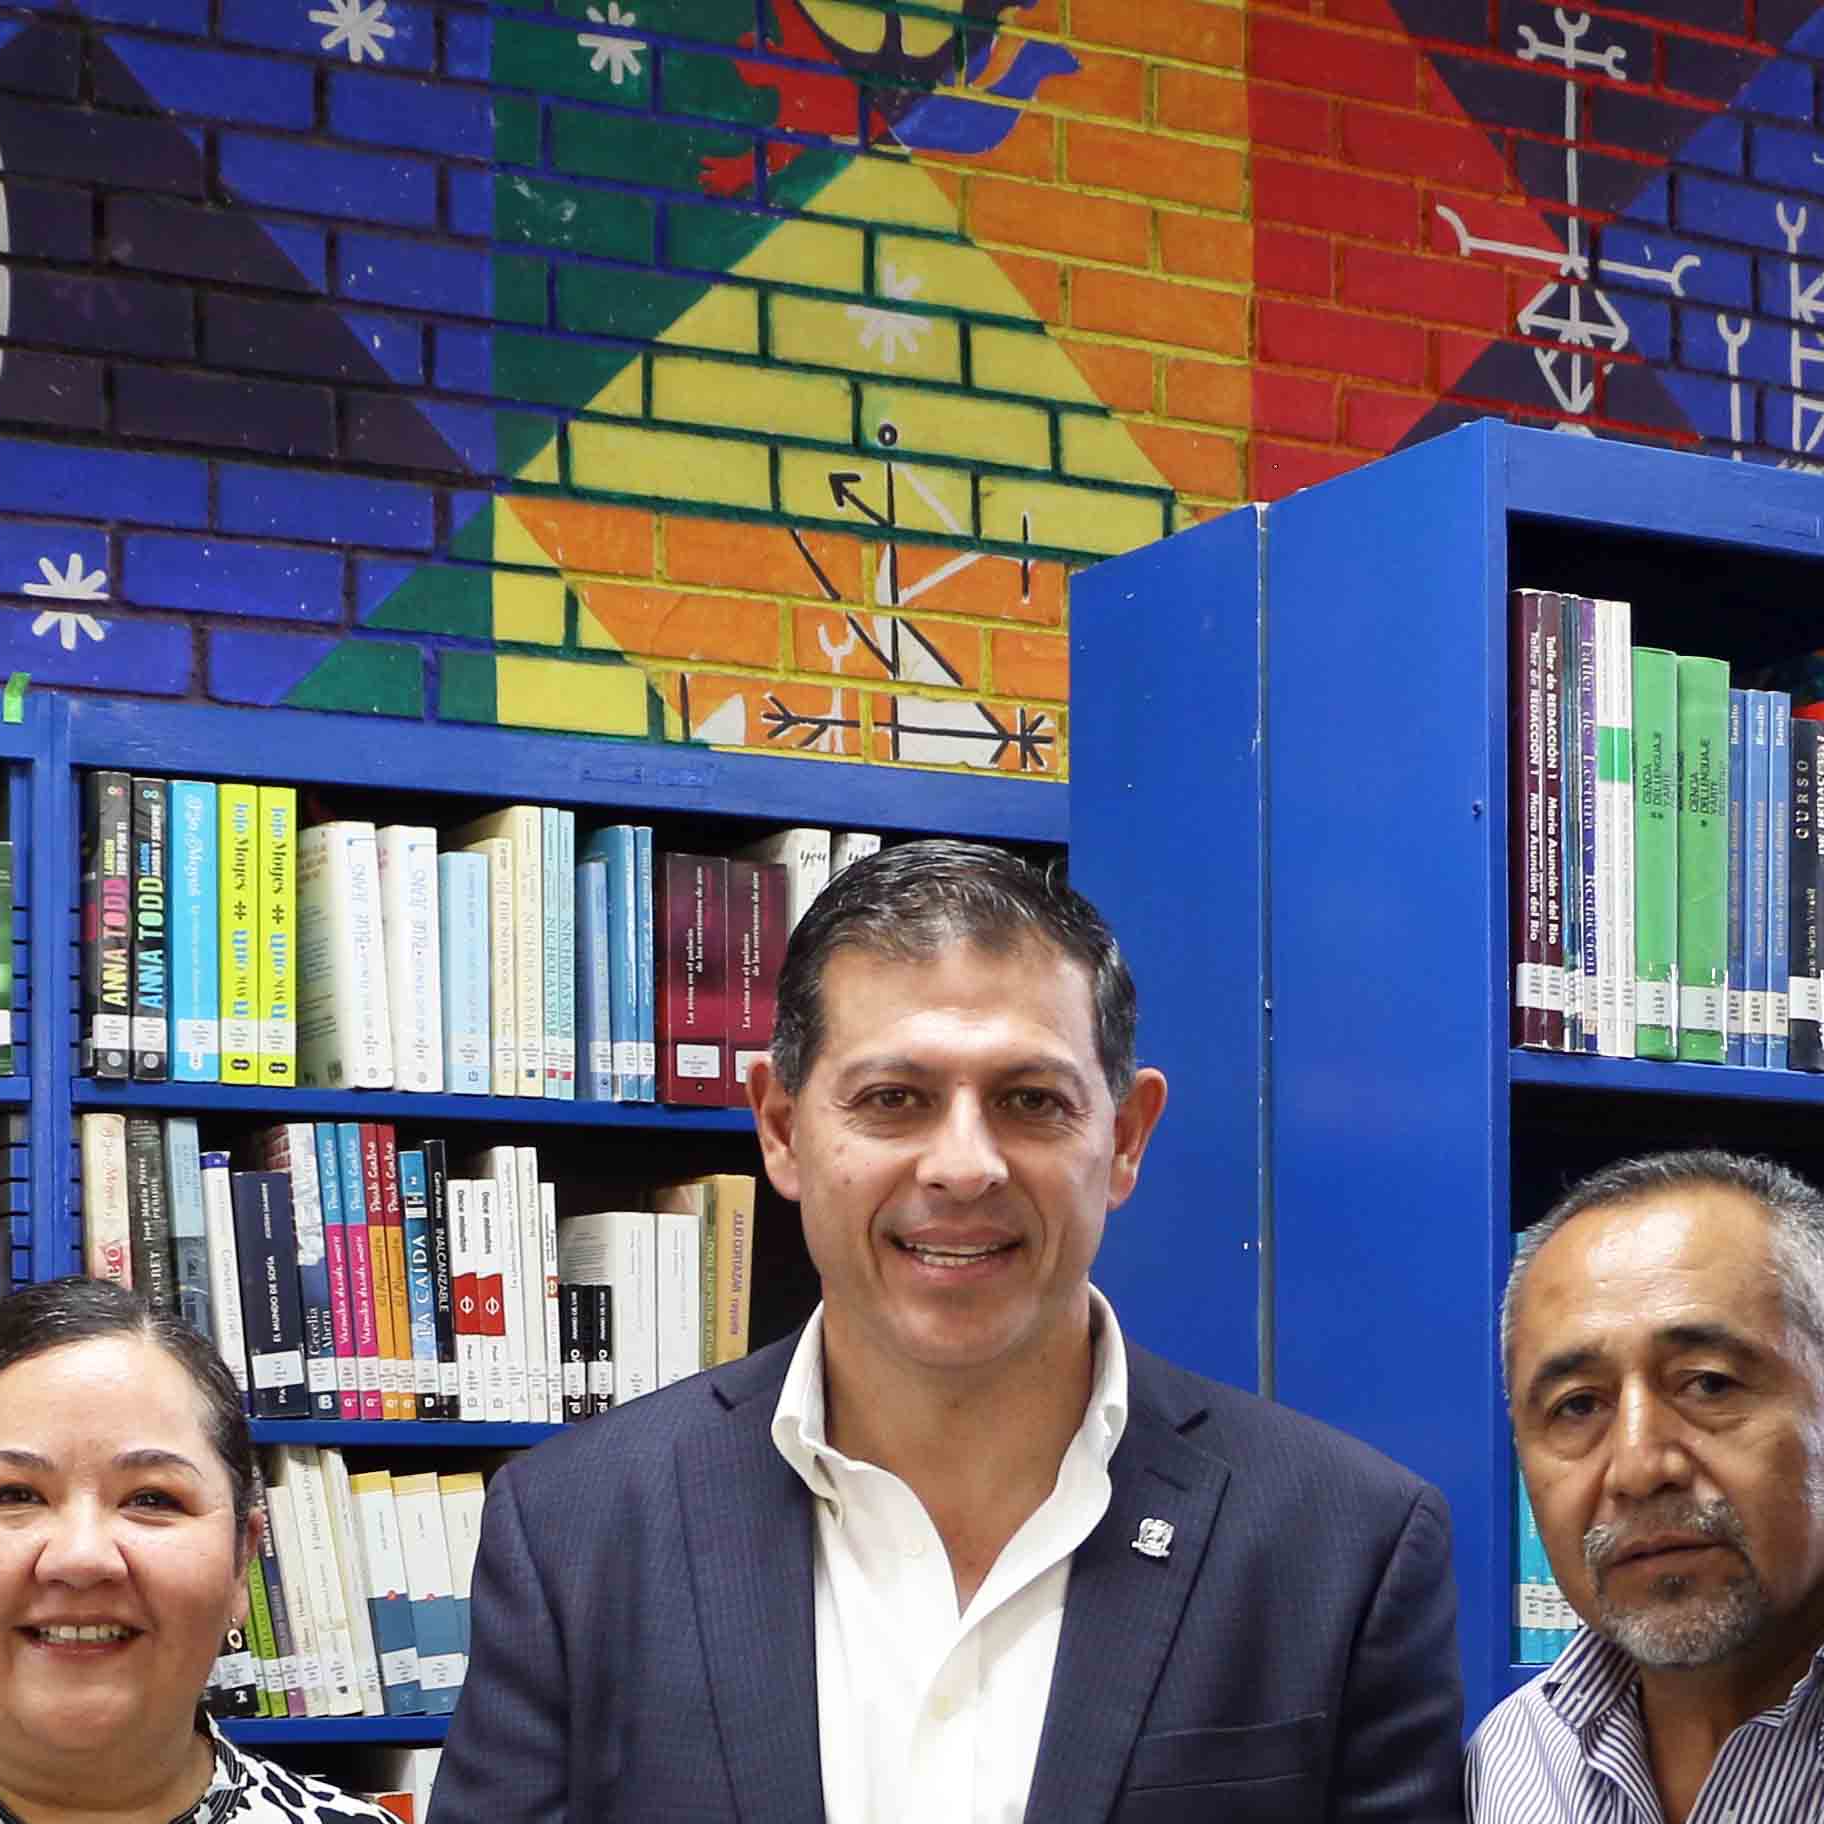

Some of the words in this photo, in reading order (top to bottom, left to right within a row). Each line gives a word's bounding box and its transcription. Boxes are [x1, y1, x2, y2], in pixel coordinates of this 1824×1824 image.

[1545, 636, 1556, 671] Taller
[1529, 669, 1540, 685] de
[1546, 674, 1557, 689] de
[1546, 693, 1559, 768] REDACCIÓN
[1775, 704, 1785, 746] Basulto
[1794, 759, 1810, 839] CURSO
[231, 803, 248, 834] Jojo
[265, 807, 287, 839] Jojo
[231, 837, 249, 891] Moyes
[263, 841, 288, 895] Moyes
[103, 880, 128, 940] TODD
[138, 878, 164, 941] TODD
[1529, 896, 1540, 916] del
[684, 928, 695, 961] palacio
[741, 933, 752, 965] palacio
[103, 948, 128, 1007] ANNA
[138, 949, 164, 1009] ANNA
[685, 986, 694, 1010] reina
[741, 990, 751, 1014] reina
[323, 1139, 335, 1180] Coelho
[346, 1138, 358, 1180] Coelho
[366, 1140, 378, 1178] Coelho
[383, 1141, 396, 1179] Coelho
[369, 1182, 382, 1212] Paulo
[386, 1182, 399, 1214] Paulo
[481, 1191, 493, 1214] Once
[458, 1215, 469, 1253] minutos
[482, 1217, 494, 1255] minutos
[266, 1255, 278, 1282] SOFÍA
[334, 1264, 345, 1298] decide
[356, 1264, 367, 1298] decide
[435, 1226, 450, 1313] INALCANZABLE
[269, 1283, 279, 1295] DE
[270, 1296, 281, 1332] MUNDO
[308, 1306, 321, 1355] Cecelia
[320, 1310, 331, 1350] Ahern
[337, 1299, 349, 1344] Veronika
[359, 1299, 372, 1344] Veronika
[416, 1309, 433, 1338] LA
[272, 1332, 282, 1343] EL
